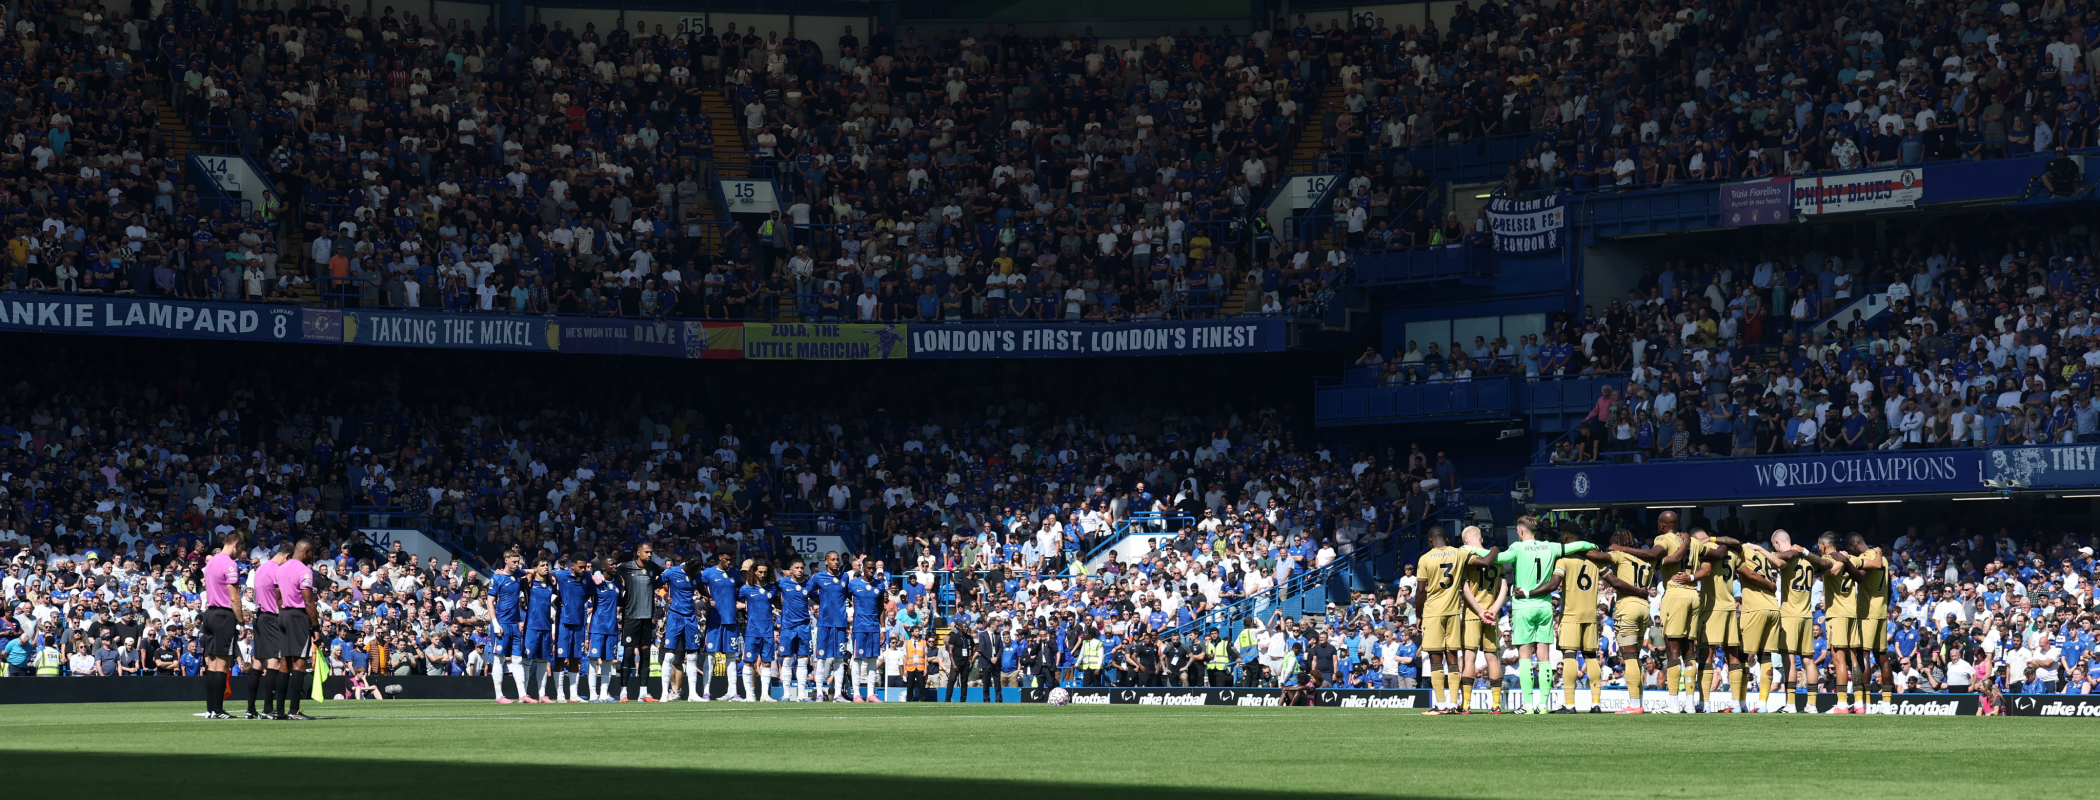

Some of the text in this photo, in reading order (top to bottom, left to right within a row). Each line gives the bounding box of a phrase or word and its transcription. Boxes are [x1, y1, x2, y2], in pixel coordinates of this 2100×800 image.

[681, 17, 704, 36] 15
[207, 158, 228, 174] 14
[735, 183, 755, 198] 15
[1307, 177, 1326, 193] 16
[1796, 179, 1892, 206] PHILLY BLUES
[1731, 189, 1748, 199] Trizia
[1491, 194, 1558, 212] ONE TEAM IN
[1492, 212, 1554, 232] CHELSEA FC
[1503, 235, 1545, 252] LONDON
[105, 302, 259, 334] LAMPARD
[269, 308, 295, 316] LAMPARD
[273, 314, 287, 339] 8
[370, 316, 533, 346] TAKING THE MIKEL
[565, 327, 628, 339] HE'S WON IT ALL
[771, 324, 840, 338] ZOLA, THE
[913, 325, 1257, 354] LONDON'S FIRST, LONDON'S FINEST
[686, 346, 700, 359] 28
[749, 341, 870, 358] LITTLE MAGICIAN
[2051, 446, 2098, 471] THEY
[1755, 461, 1827, 487] WORLD
[1831, 456, 1957, 484] CHAMPIONS
[371, 532, 391, 548] 14
[797, 537, 818, 553] 15
[1439, 562, 1455, 590] 3
[1534, 557, 1541, 584] 1
[1631, 561, 1654, 589] 10
[1721, 554, 1733, 582] 5
[1476, 565, 1499, 591] 19
[1576, 563, 1593, 592] 6
[1791, 564, 1814, 591] 20
[1138, 692, 1207, 706] nike football
[1237, 693, 1262, 707] nike
[1340, 694, 1416, 709] nike football
[1600, 698, 1625, 710] ECURE
[1900, 700, 1959, 716] football
[2040, 701, 2076, 716] nike
